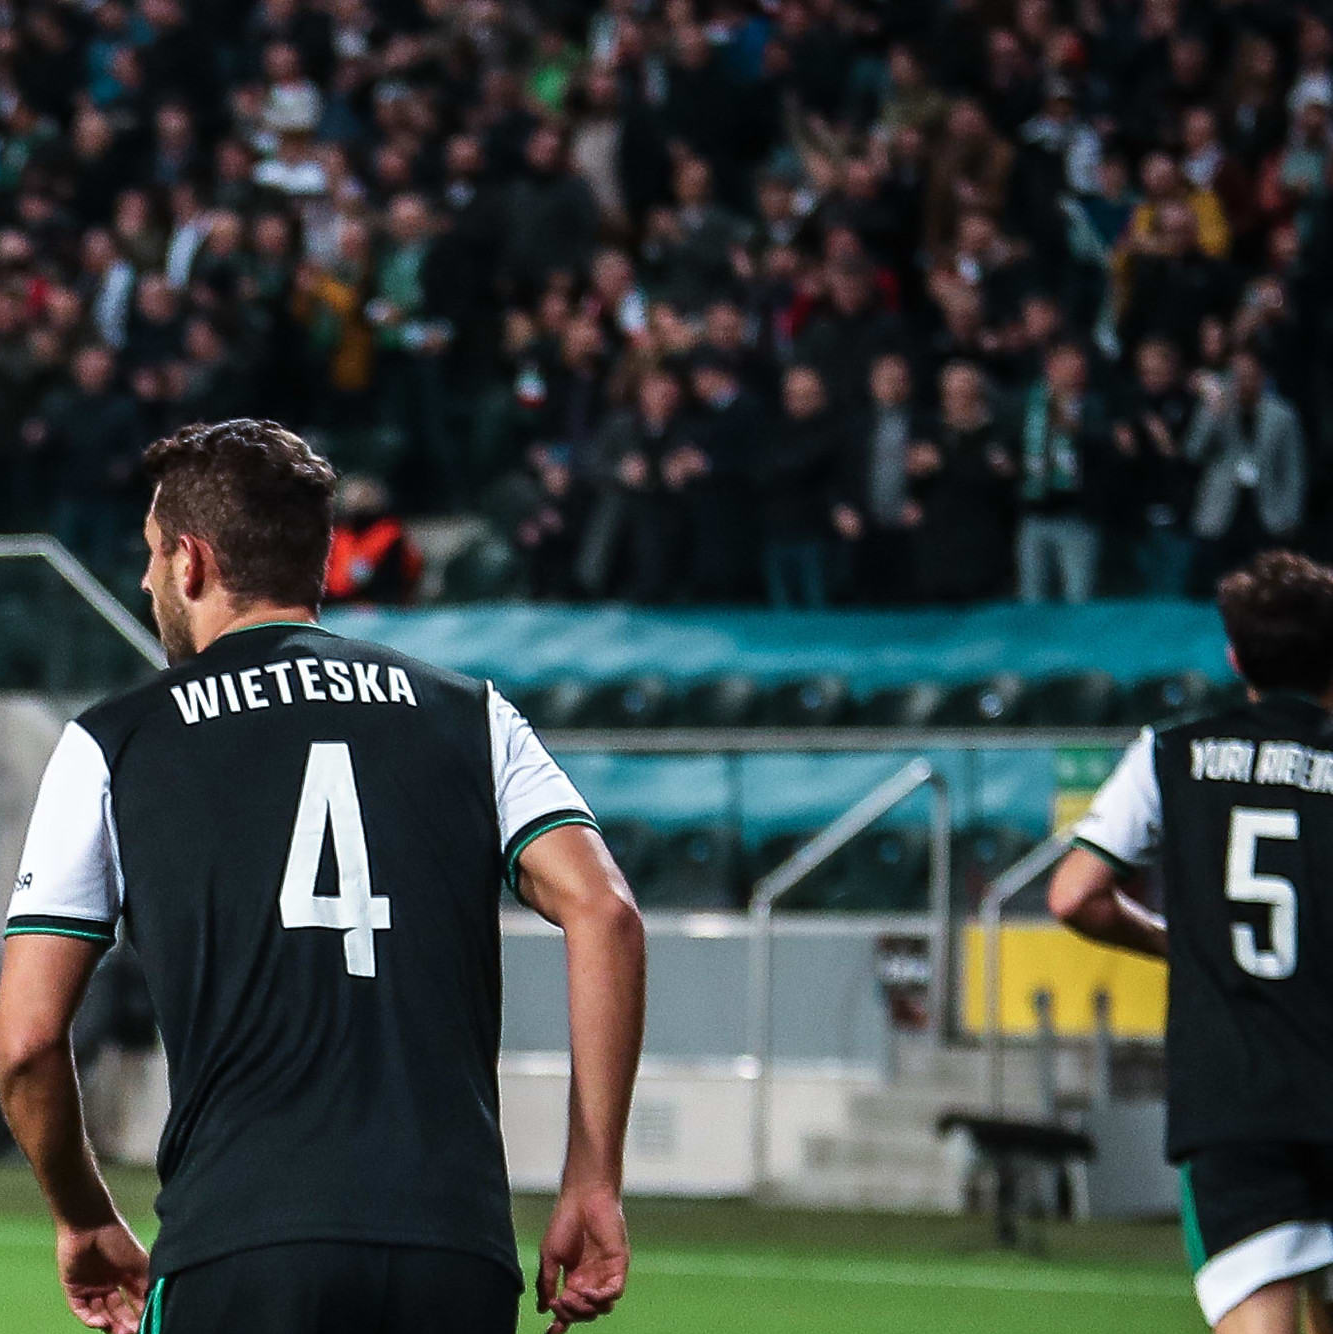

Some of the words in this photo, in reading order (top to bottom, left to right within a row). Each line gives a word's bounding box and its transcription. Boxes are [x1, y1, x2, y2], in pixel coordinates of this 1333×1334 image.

[170, 656, 418, 725] WIETESKA
[278, 740, 390, 978] 4
[1225, 805, 1300, 980] 5
